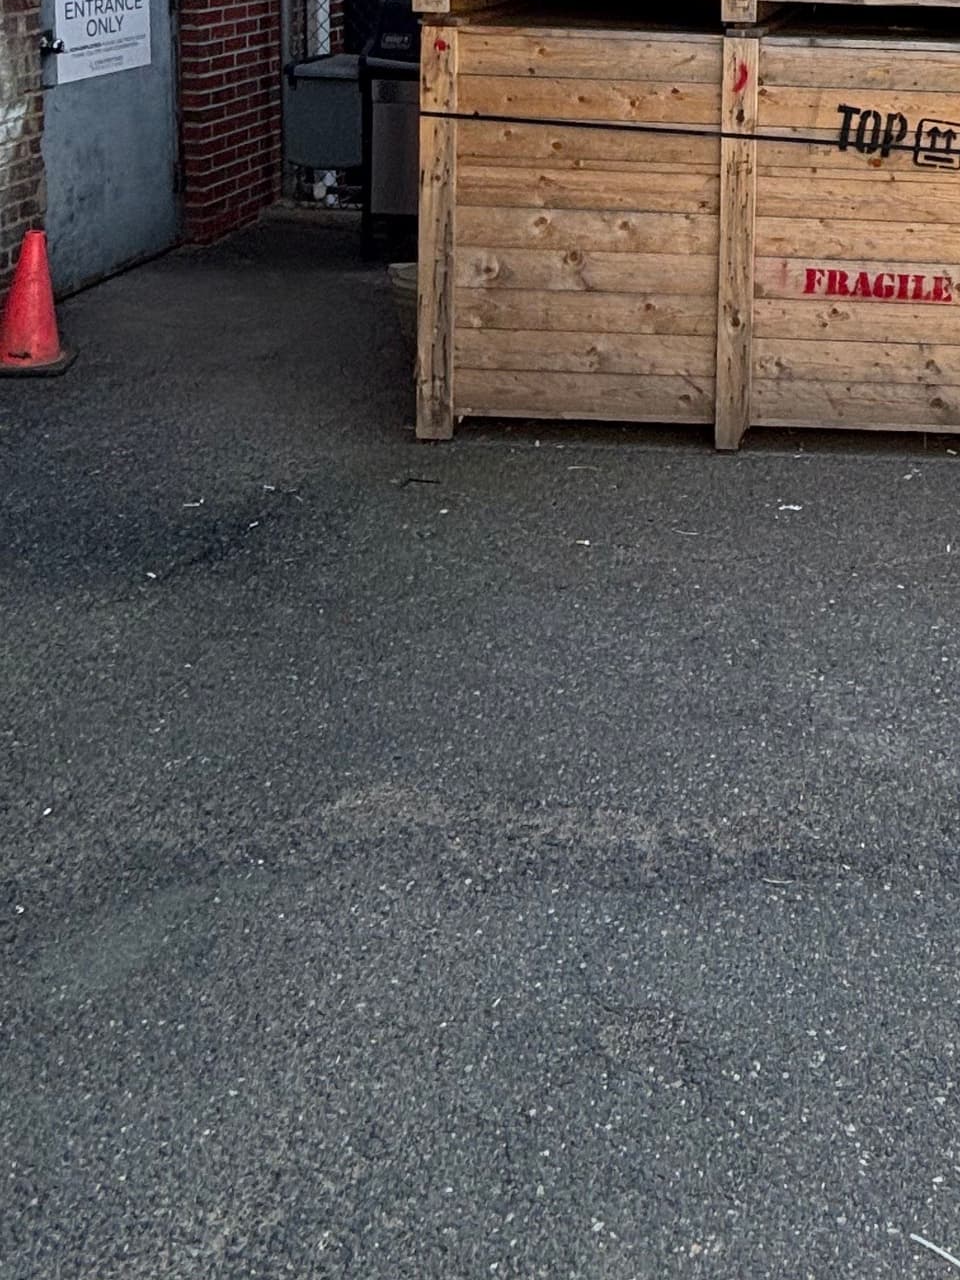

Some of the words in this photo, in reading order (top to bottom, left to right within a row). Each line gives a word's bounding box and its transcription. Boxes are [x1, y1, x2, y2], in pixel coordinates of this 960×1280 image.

[86, 14, 124, 37] ONLY
[837, 104, 908, 157] TOP
[803, 268, 953, 302] FRAGILE
